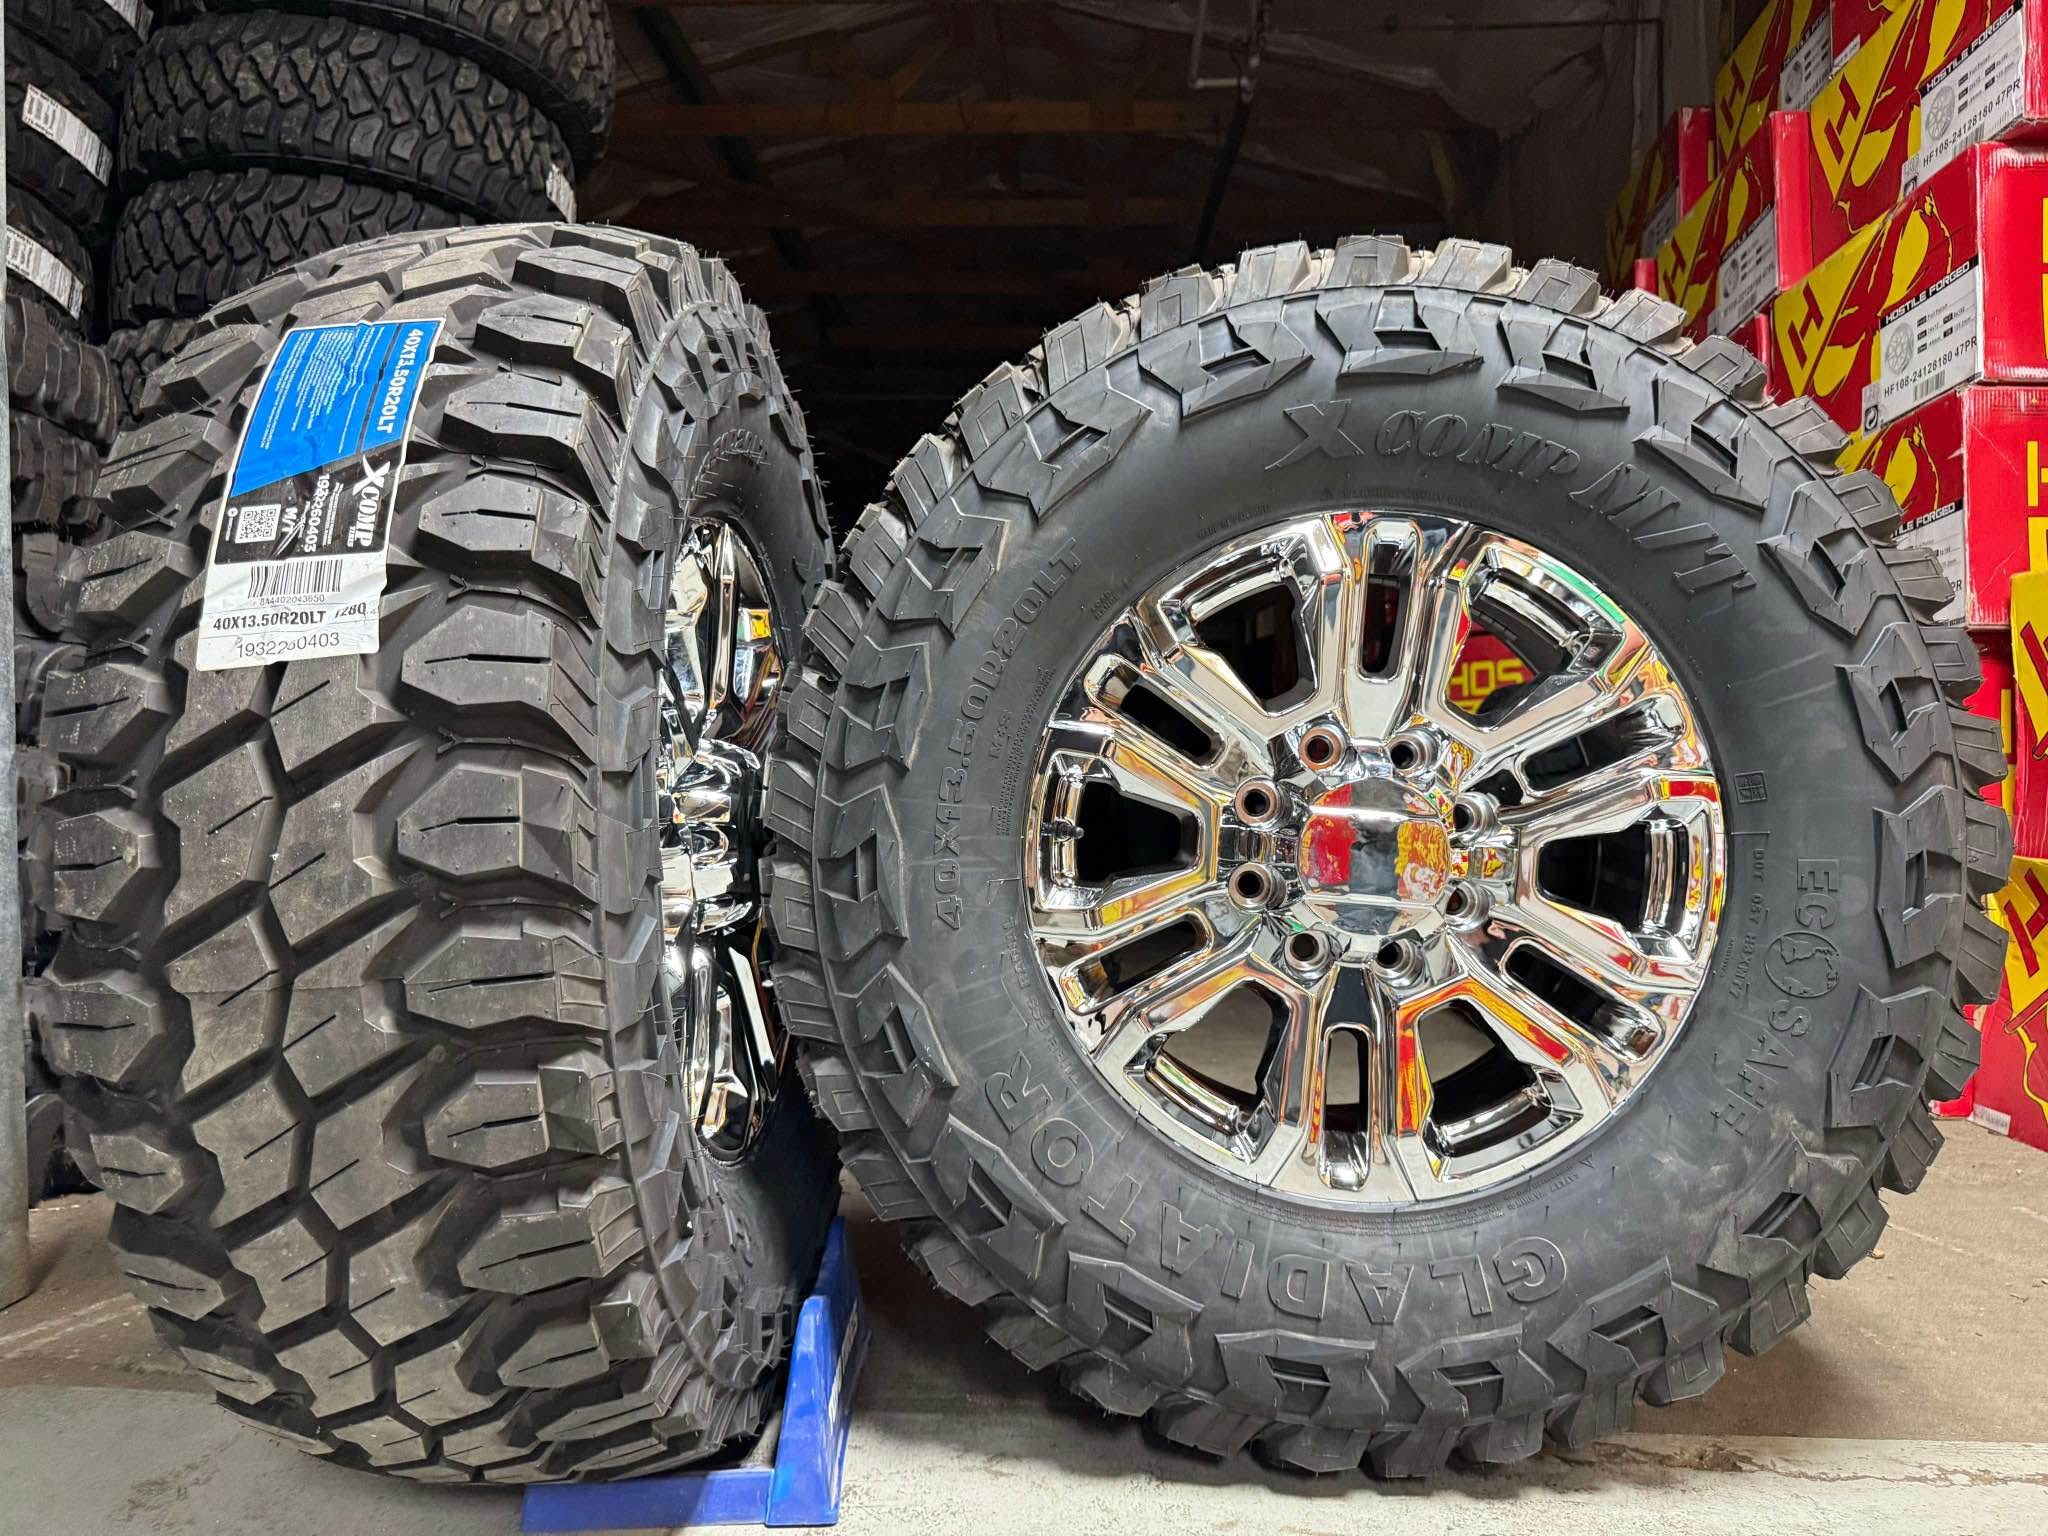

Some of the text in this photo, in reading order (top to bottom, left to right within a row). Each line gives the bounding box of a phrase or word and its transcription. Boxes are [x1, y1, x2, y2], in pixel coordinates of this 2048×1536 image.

[1926, 50, 1970, 93] HOSTILE
[1971, 5, 2015, 56] FORGED
[1885, 261, 1970, 324] HOSTILE FORGED
[1954, 335, 1977, 358] 47PR
[376, 328, 424, 434] 40X13.50R20LT
[1916, 502, 1956, 528] FORGED
[212, 610, 327, 631] 40X13.50R20LT
[983, 1047, 1568, 1327] GLADIATOR
